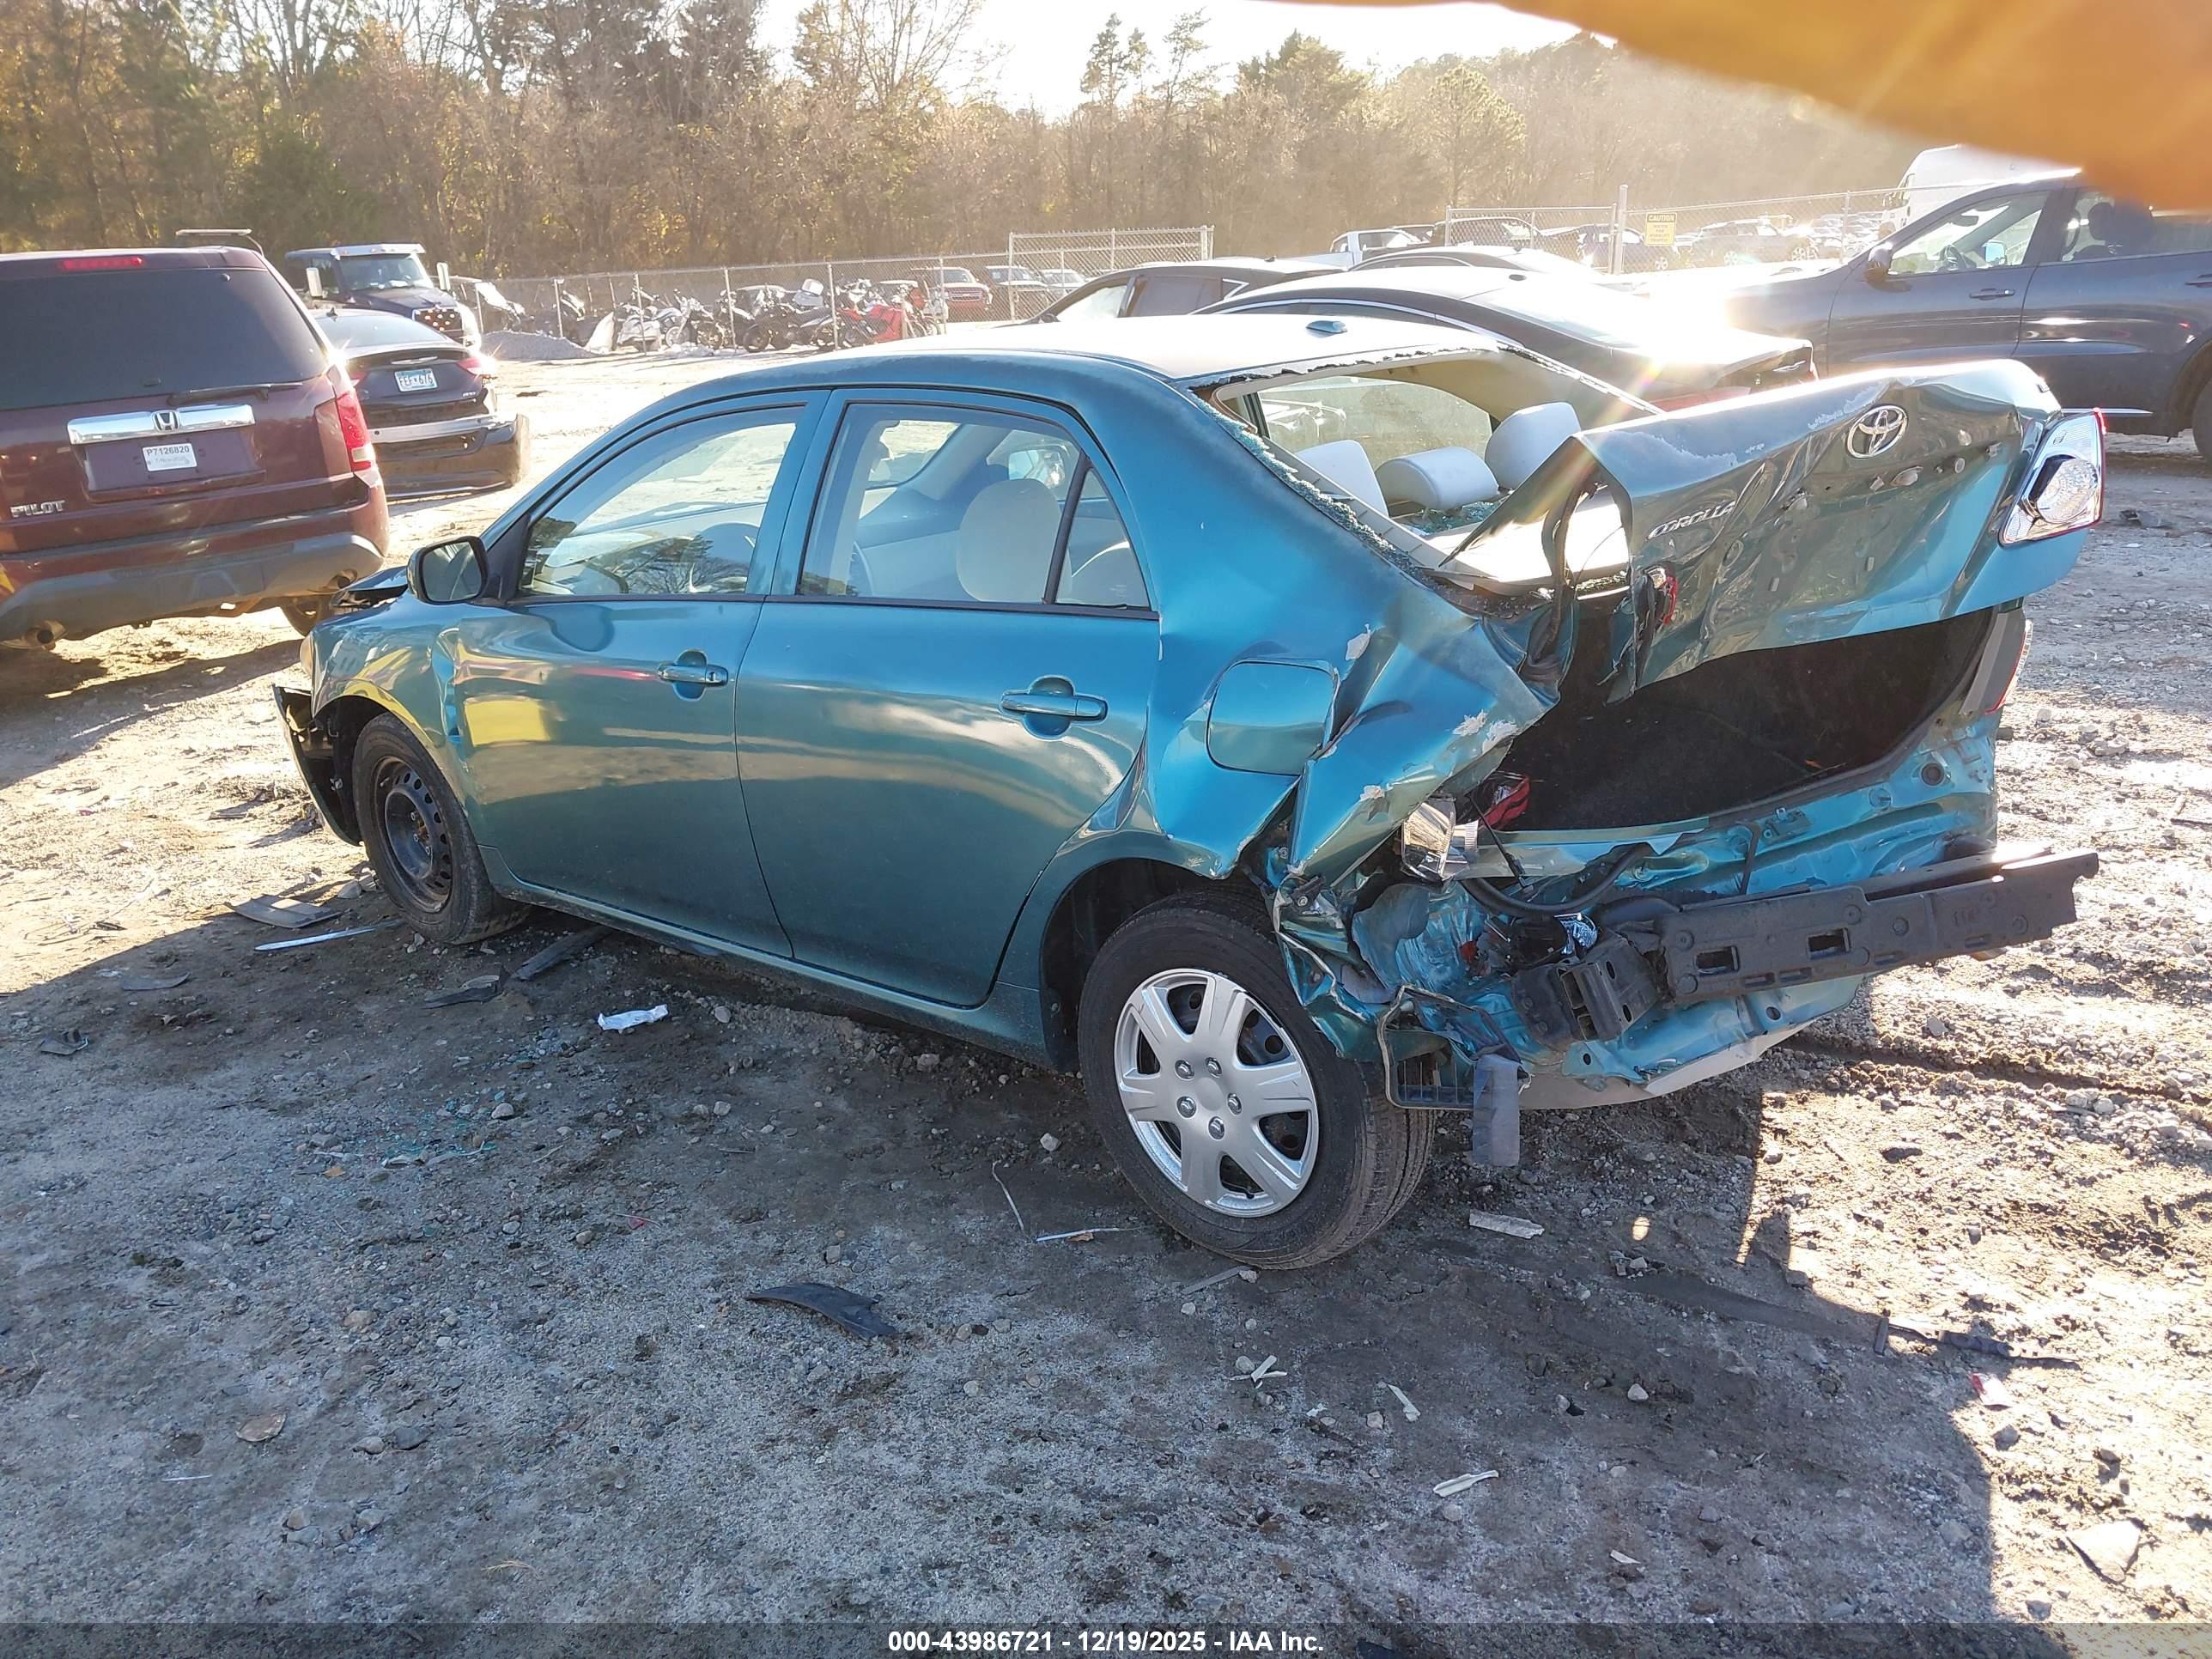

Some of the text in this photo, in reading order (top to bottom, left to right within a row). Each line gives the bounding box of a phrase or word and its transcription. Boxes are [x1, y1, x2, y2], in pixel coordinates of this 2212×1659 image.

[146, 446, 190, 456] P7126820
[9, 500, 65, 518] PILOT
[1648, 501, 1735, 540] COROLLA
